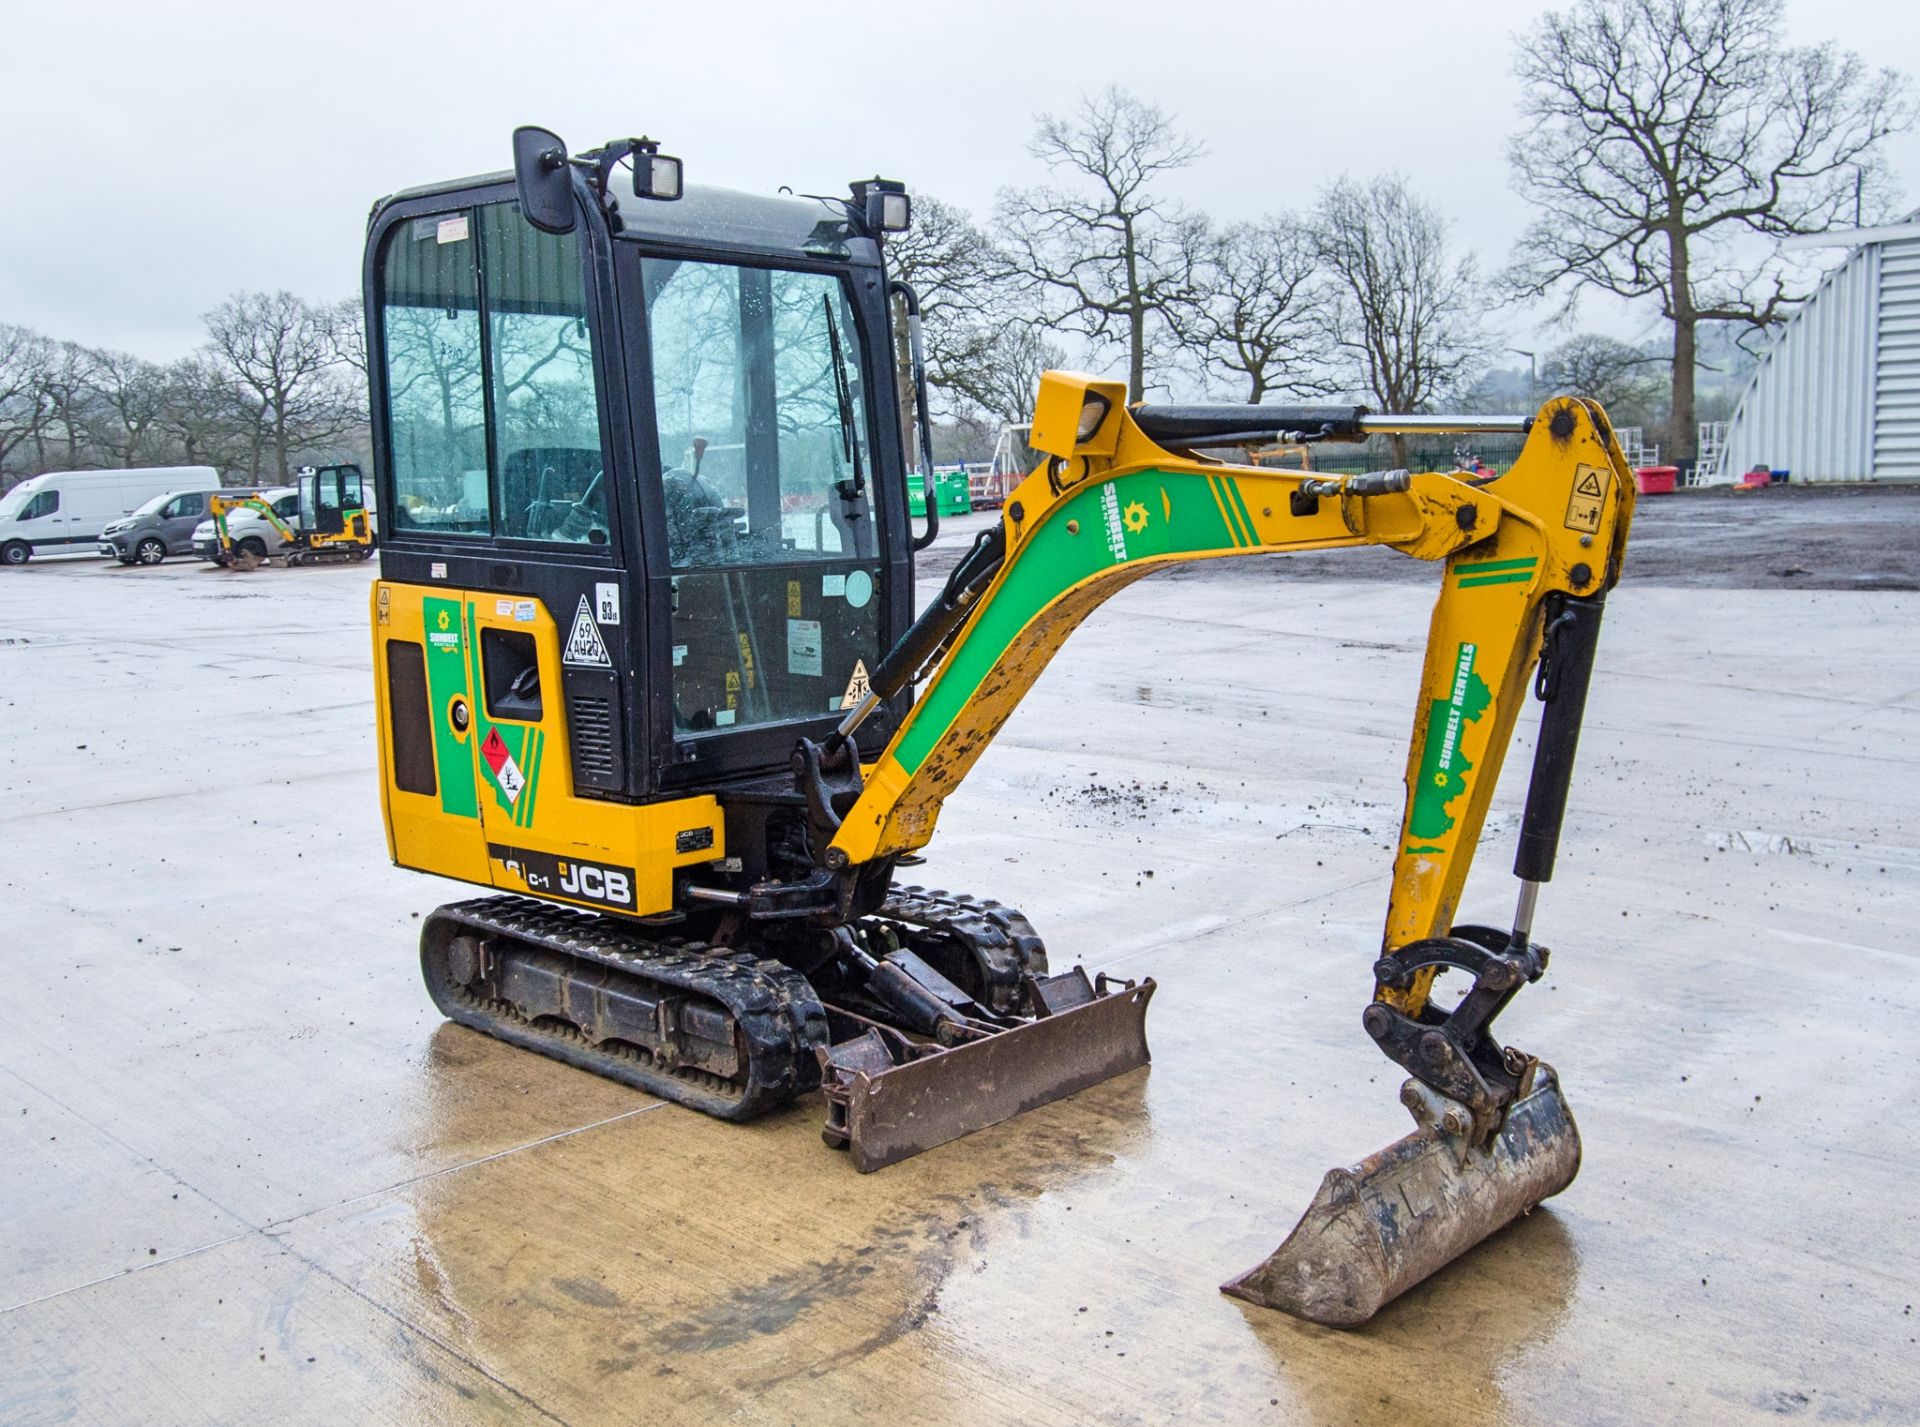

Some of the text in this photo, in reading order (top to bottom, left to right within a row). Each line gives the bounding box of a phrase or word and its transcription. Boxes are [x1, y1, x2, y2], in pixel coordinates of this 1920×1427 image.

[1100, 495, 1114, 552] RENTALS
[1103, 482, 1127, 560] SUNBELT
[579, 622, 592, 639] 69
[602, 601, 612, 620] 93
[429, 632, 459, 643] SUNBELT
[1439, 643, 1474, 770] SUNBELT RENTALS
[560, 863, 631, 904] JCB
